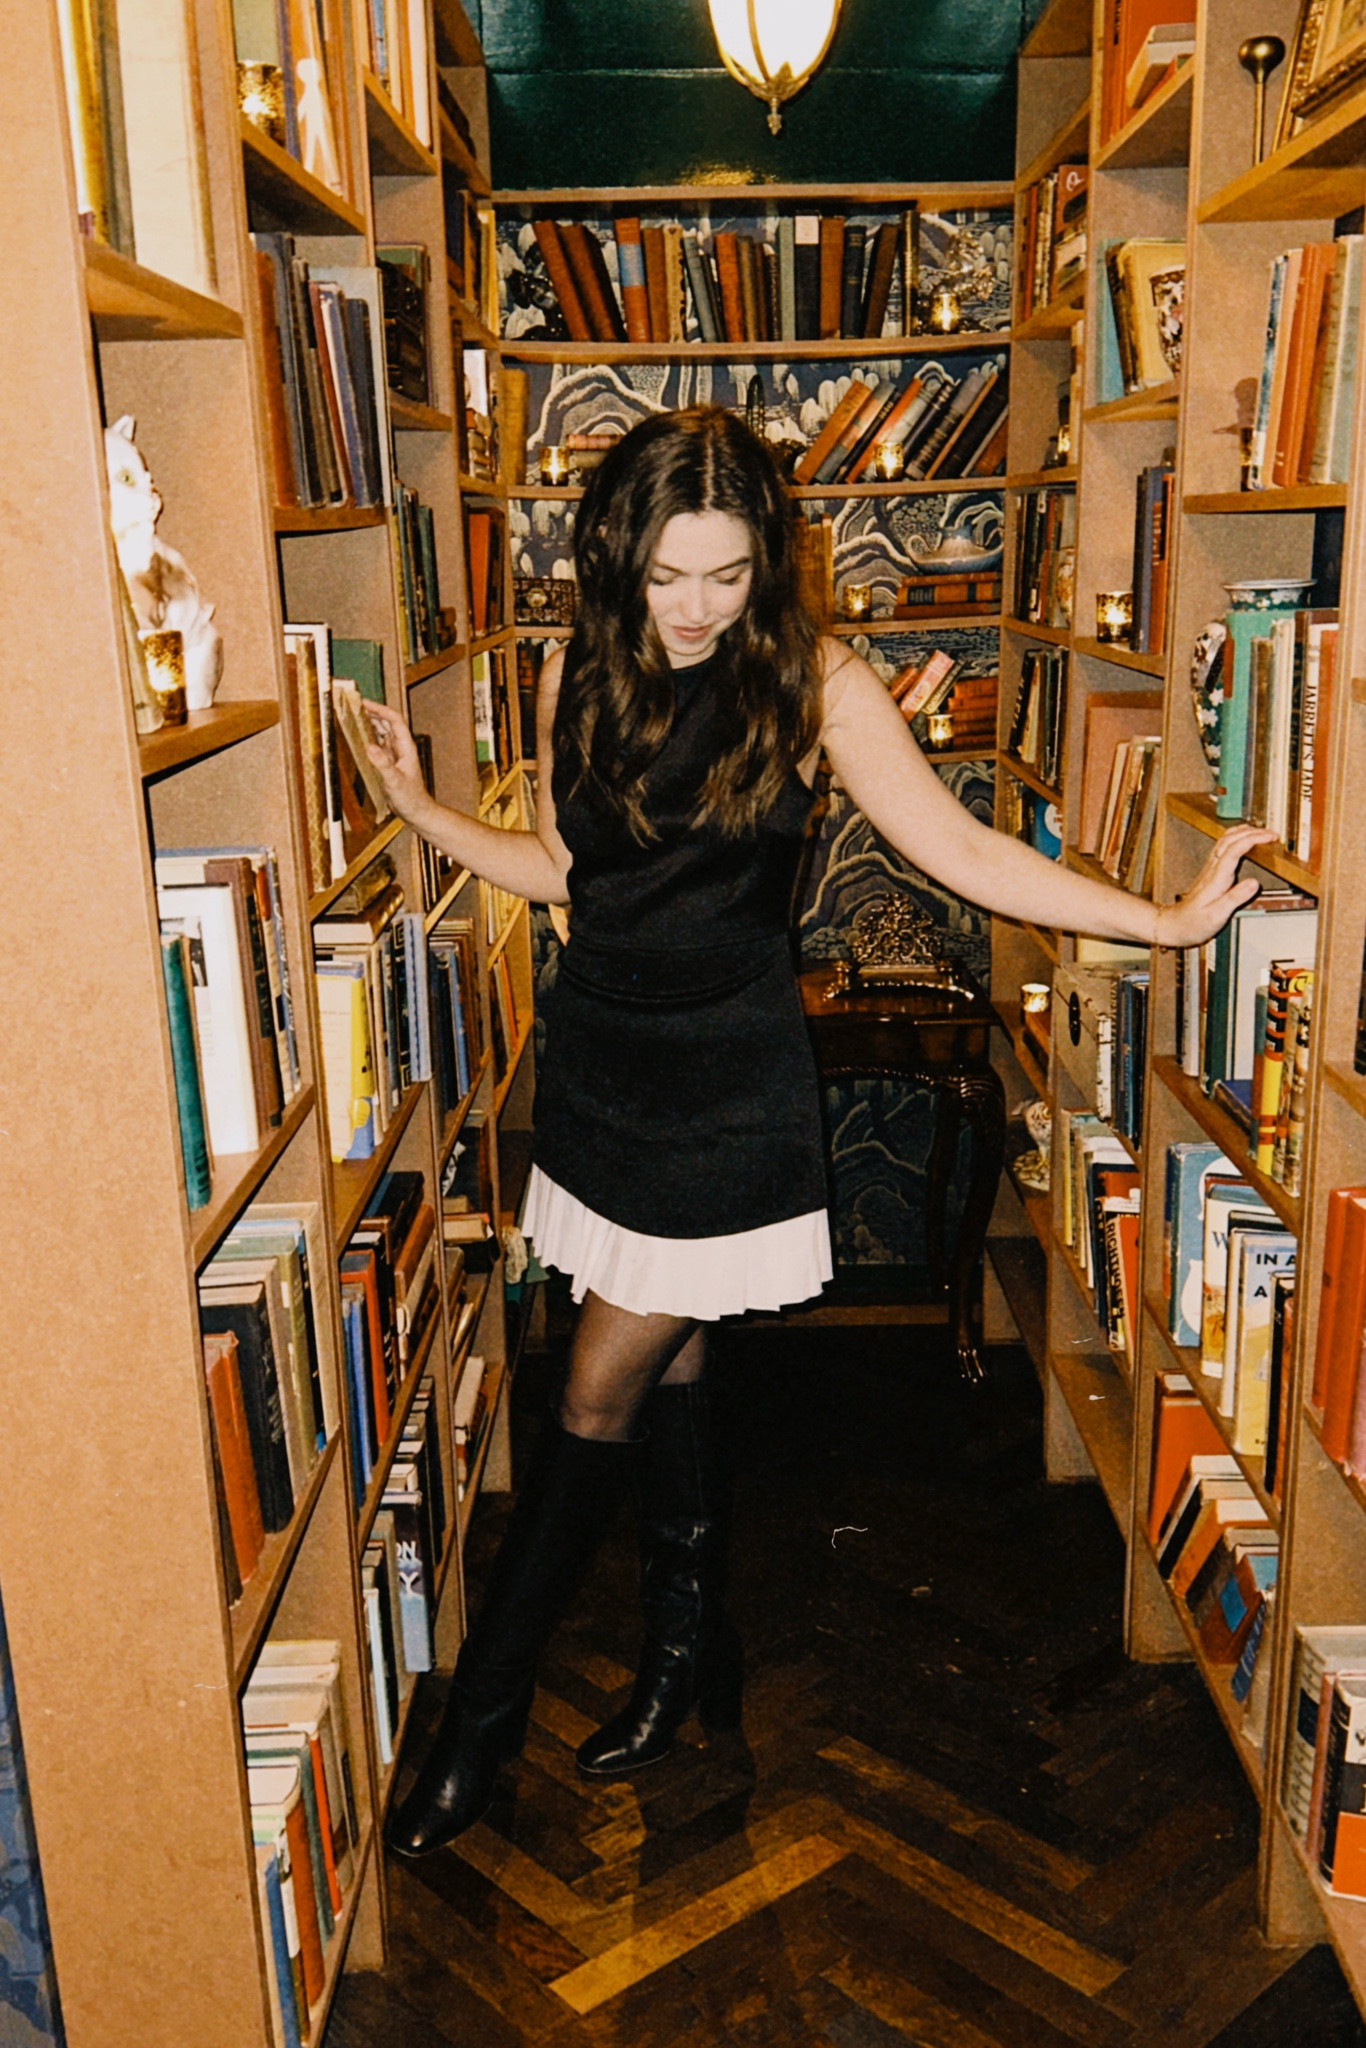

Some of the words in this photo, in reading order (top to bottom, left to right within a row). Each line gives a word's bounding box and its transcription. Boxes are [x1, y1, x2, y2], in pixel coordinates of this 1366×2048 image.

[1303, 683, 1317, 761] JARRETT'S
[1300, 768, 1315, 803] JADE
[1256, 1253, 1278, 1265] IN
[1253, 1285, 1268, 1297] A
